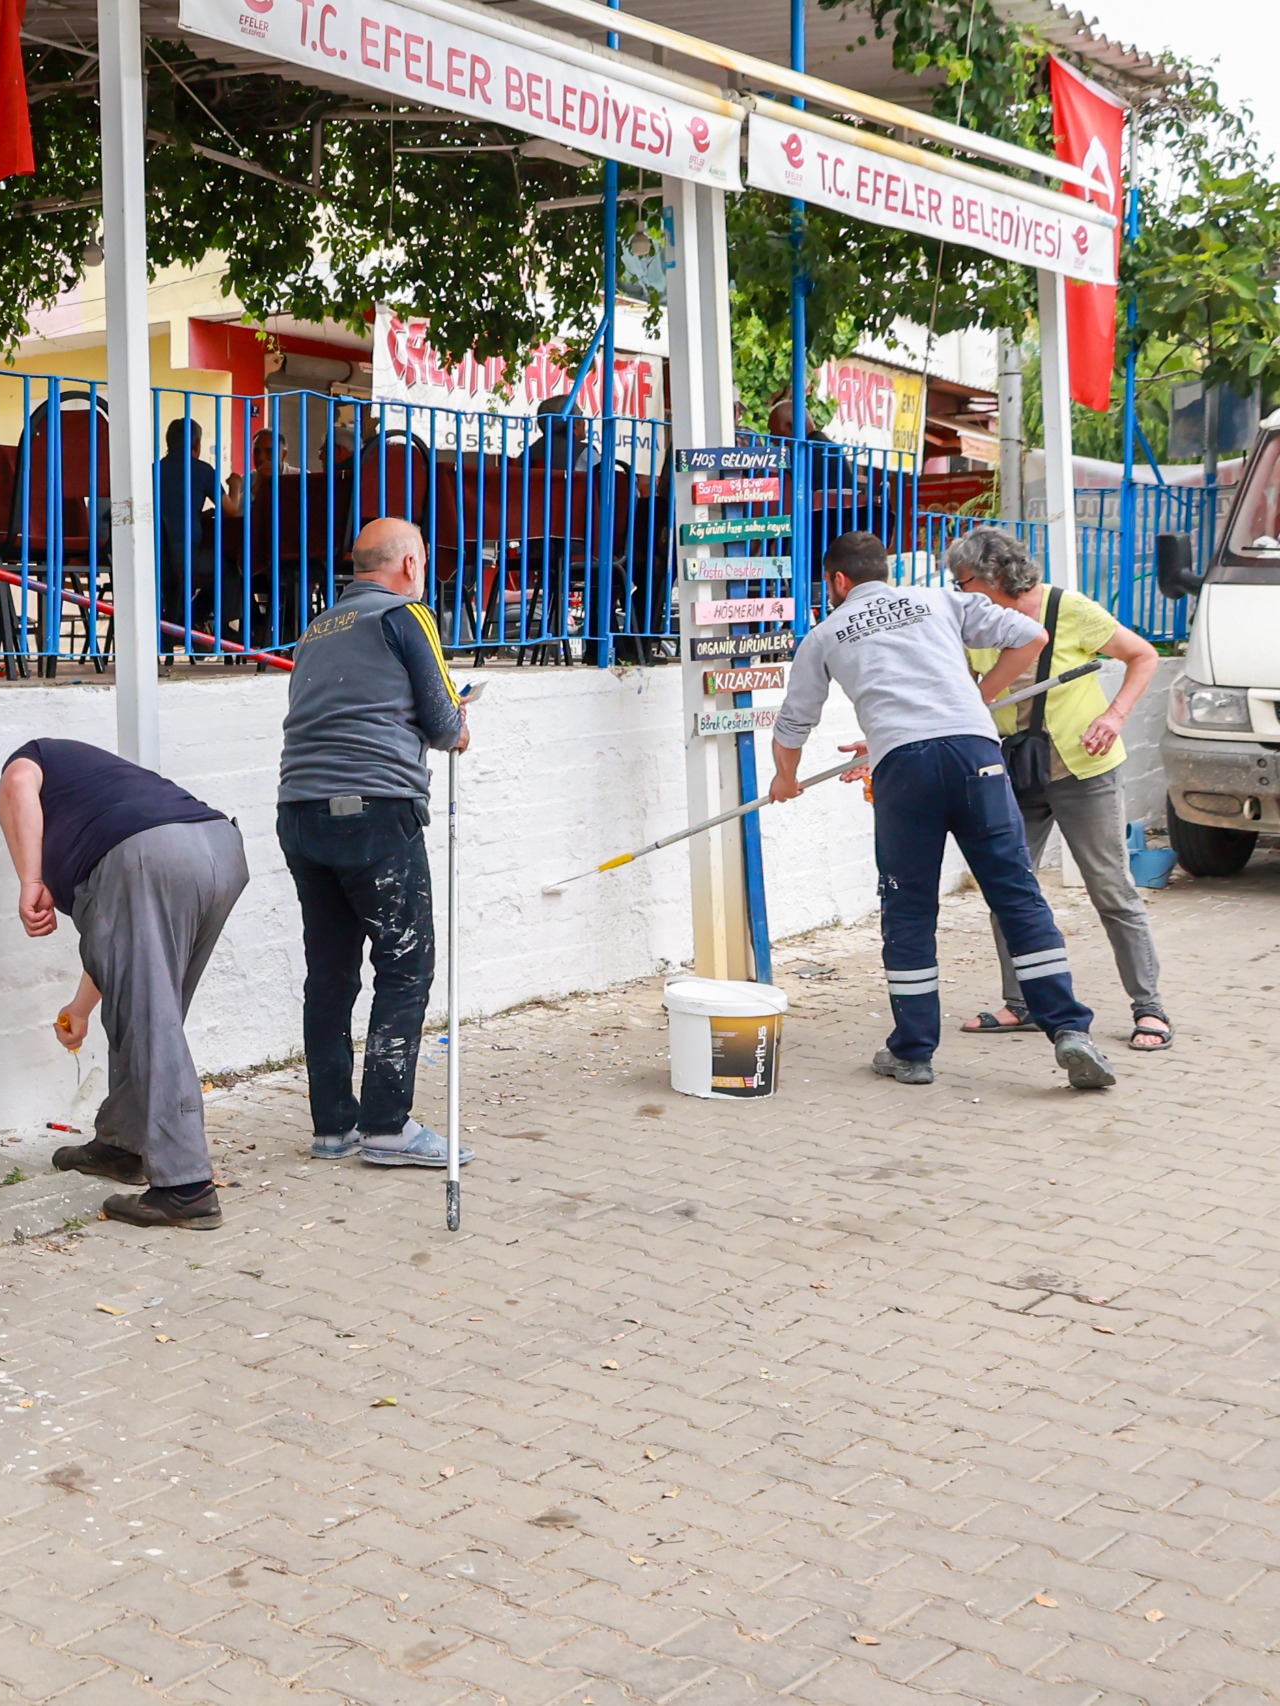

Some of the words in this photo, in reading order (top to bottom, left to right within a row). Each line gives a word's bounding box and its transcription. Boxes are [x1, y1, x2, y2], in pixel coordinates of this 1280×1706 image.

[239, 14, 269, 31] EFELER
[296, 0, 347, 60] T.C.
[360, 18, 492, 105] EFELER
[505, 67, 672, 157] BELEDİYESİ
[817, 151, 850, 199] T.C.
[857, 166, 943, 226] EFELER
[953, 195, 1062, 259] BELEDİYESİ
[691, 452, 716, 468] HOŞ
[848, 598, 910, 624] EFELER
[864, 597, 890, 609] T.C.
[836, 604, 931, 641] BELEDİYESİ
[697, 636, 736, 655] ORGANİK
[738, 633, 787, 653] ÜRÜNLER
[753, 1025, 768, 1089] Peritus
